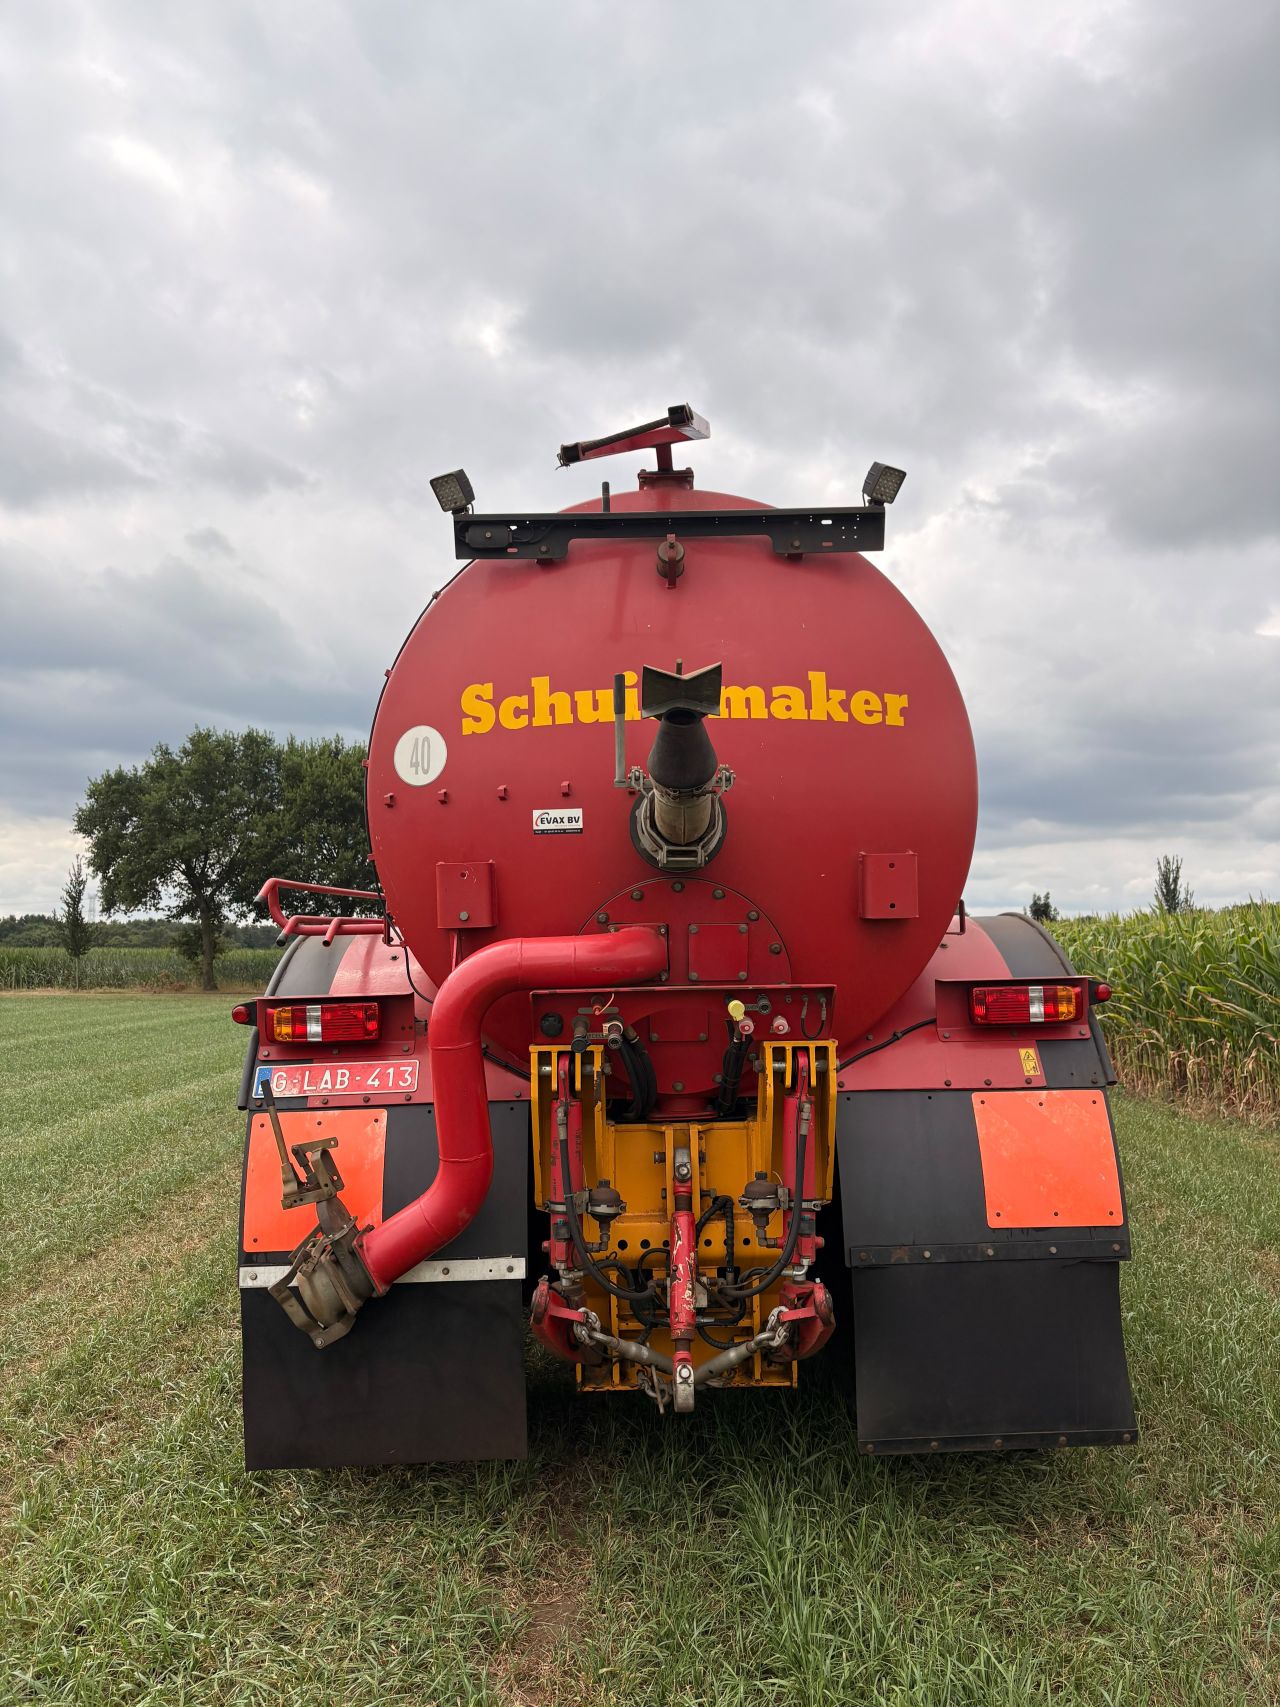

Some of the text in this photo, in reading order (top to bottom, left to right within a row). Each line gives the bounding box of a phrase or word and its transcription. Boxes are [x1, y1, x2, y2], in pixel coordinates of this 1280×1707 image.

[460, 670, 909, 735] Schuimaker
[410, 736, 431, 775] 40
[540, 816, 580, 825] EVAX BV
